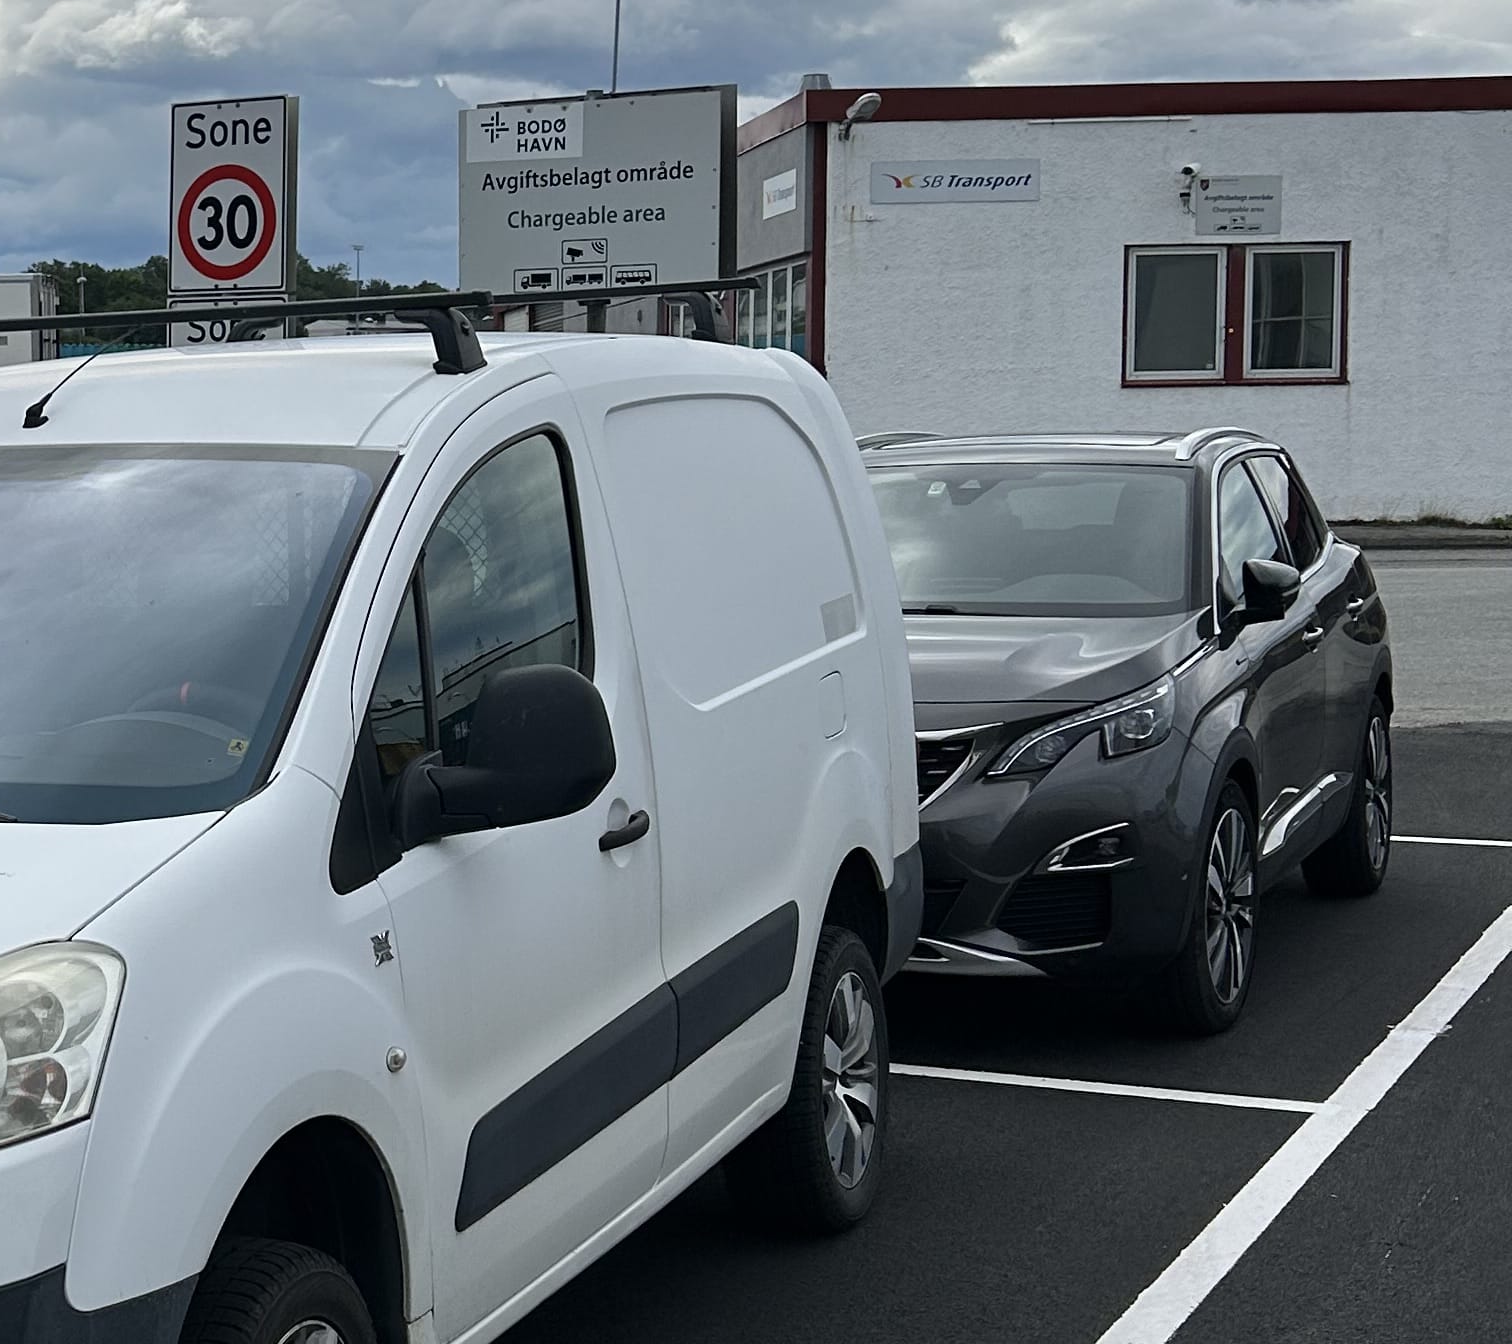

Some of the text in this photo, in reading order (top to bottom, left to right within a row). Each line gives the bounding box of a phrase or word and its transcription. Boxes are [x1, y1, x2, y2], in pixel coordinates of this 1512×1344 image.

[185, 112, 272, 149] Sone
[517, 118, 567, 135] BODØ
[517, 136, 567, 153] HAVN
[482, 160, 694, 194] Avgiftsbelagt område
[947, 173, 1032, 191] Transport
[197, 194, 258, 251] 30
[507, 206, 666, 231] Chargeable area
